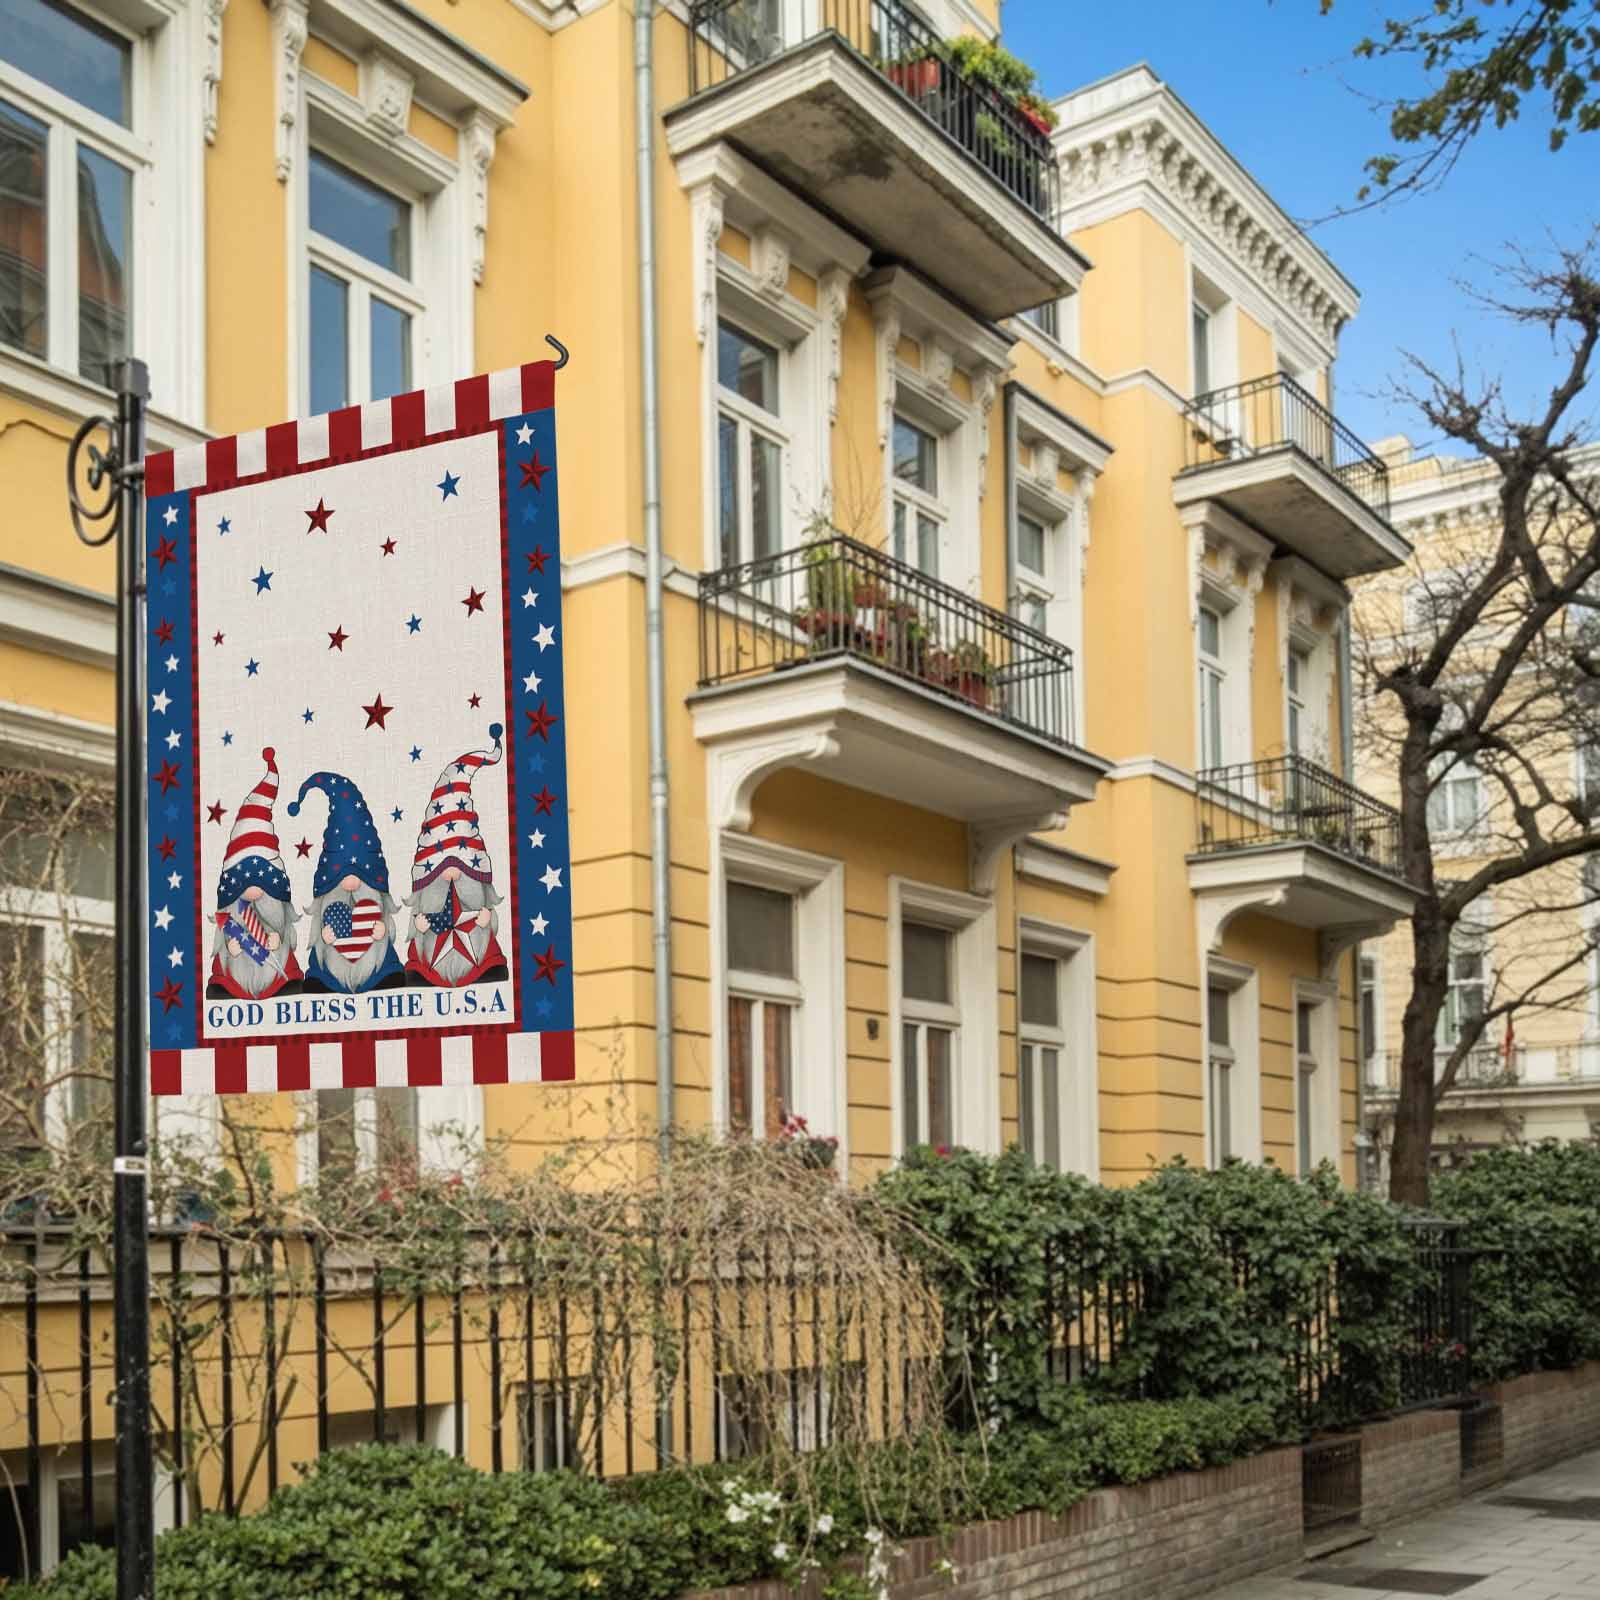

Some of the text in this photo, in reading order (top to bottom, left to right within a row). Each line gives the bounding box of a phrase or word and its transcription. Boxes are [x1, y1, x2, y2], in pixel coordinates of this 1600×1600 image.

[208, 987, 507, 1028] GOD BLESS THE U.S.A
